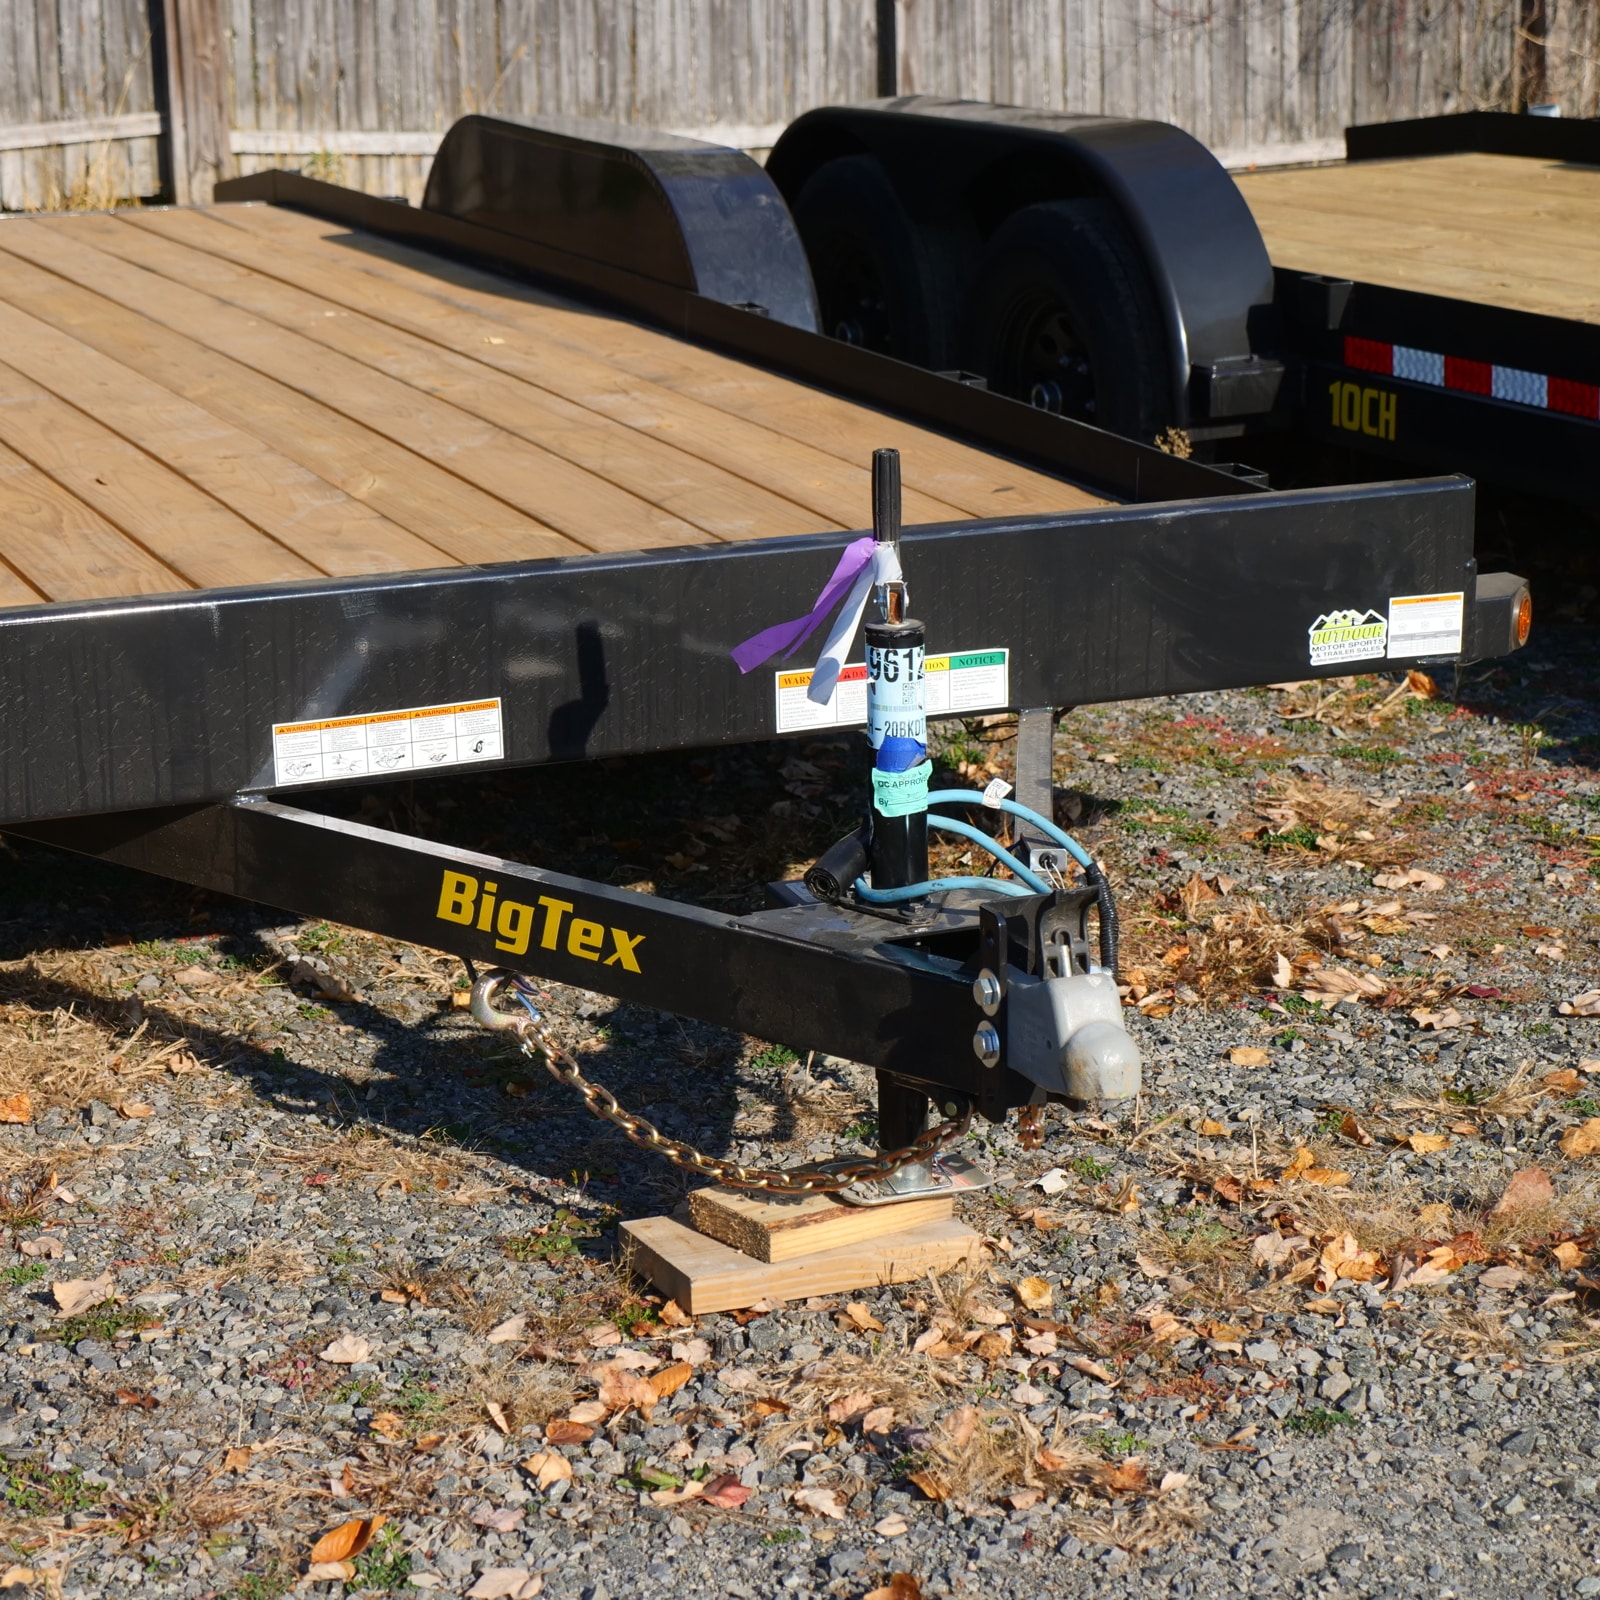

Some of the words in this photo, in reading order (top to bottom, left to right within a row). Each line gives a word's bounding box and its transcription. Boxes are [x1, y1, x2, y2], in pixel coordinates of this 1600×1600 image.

[1328, 380, 1398, 441] 10CH
[1311, 623, 1385, 646] OUTDOOR
[1311, 643, 1346, 653] MOTOR
[1347, 638, 1384, 648] SPORTS
[1323, 648, 1355, 658] TRAILER
[1356, 645, 1381, 653] SALES
[959, 655, 996, 666] NOTICE
[465, 702, 496, 711] WARNING
[375, 713, 408, 722] WARNING
[420, 708, 452, 717] WARNING
[285, 723, 317, 733] WARNING
[331, 718, 363, 728] WARNING
[878, 798, 889, 807] By
[436, 869, 647, 974] BigTex
